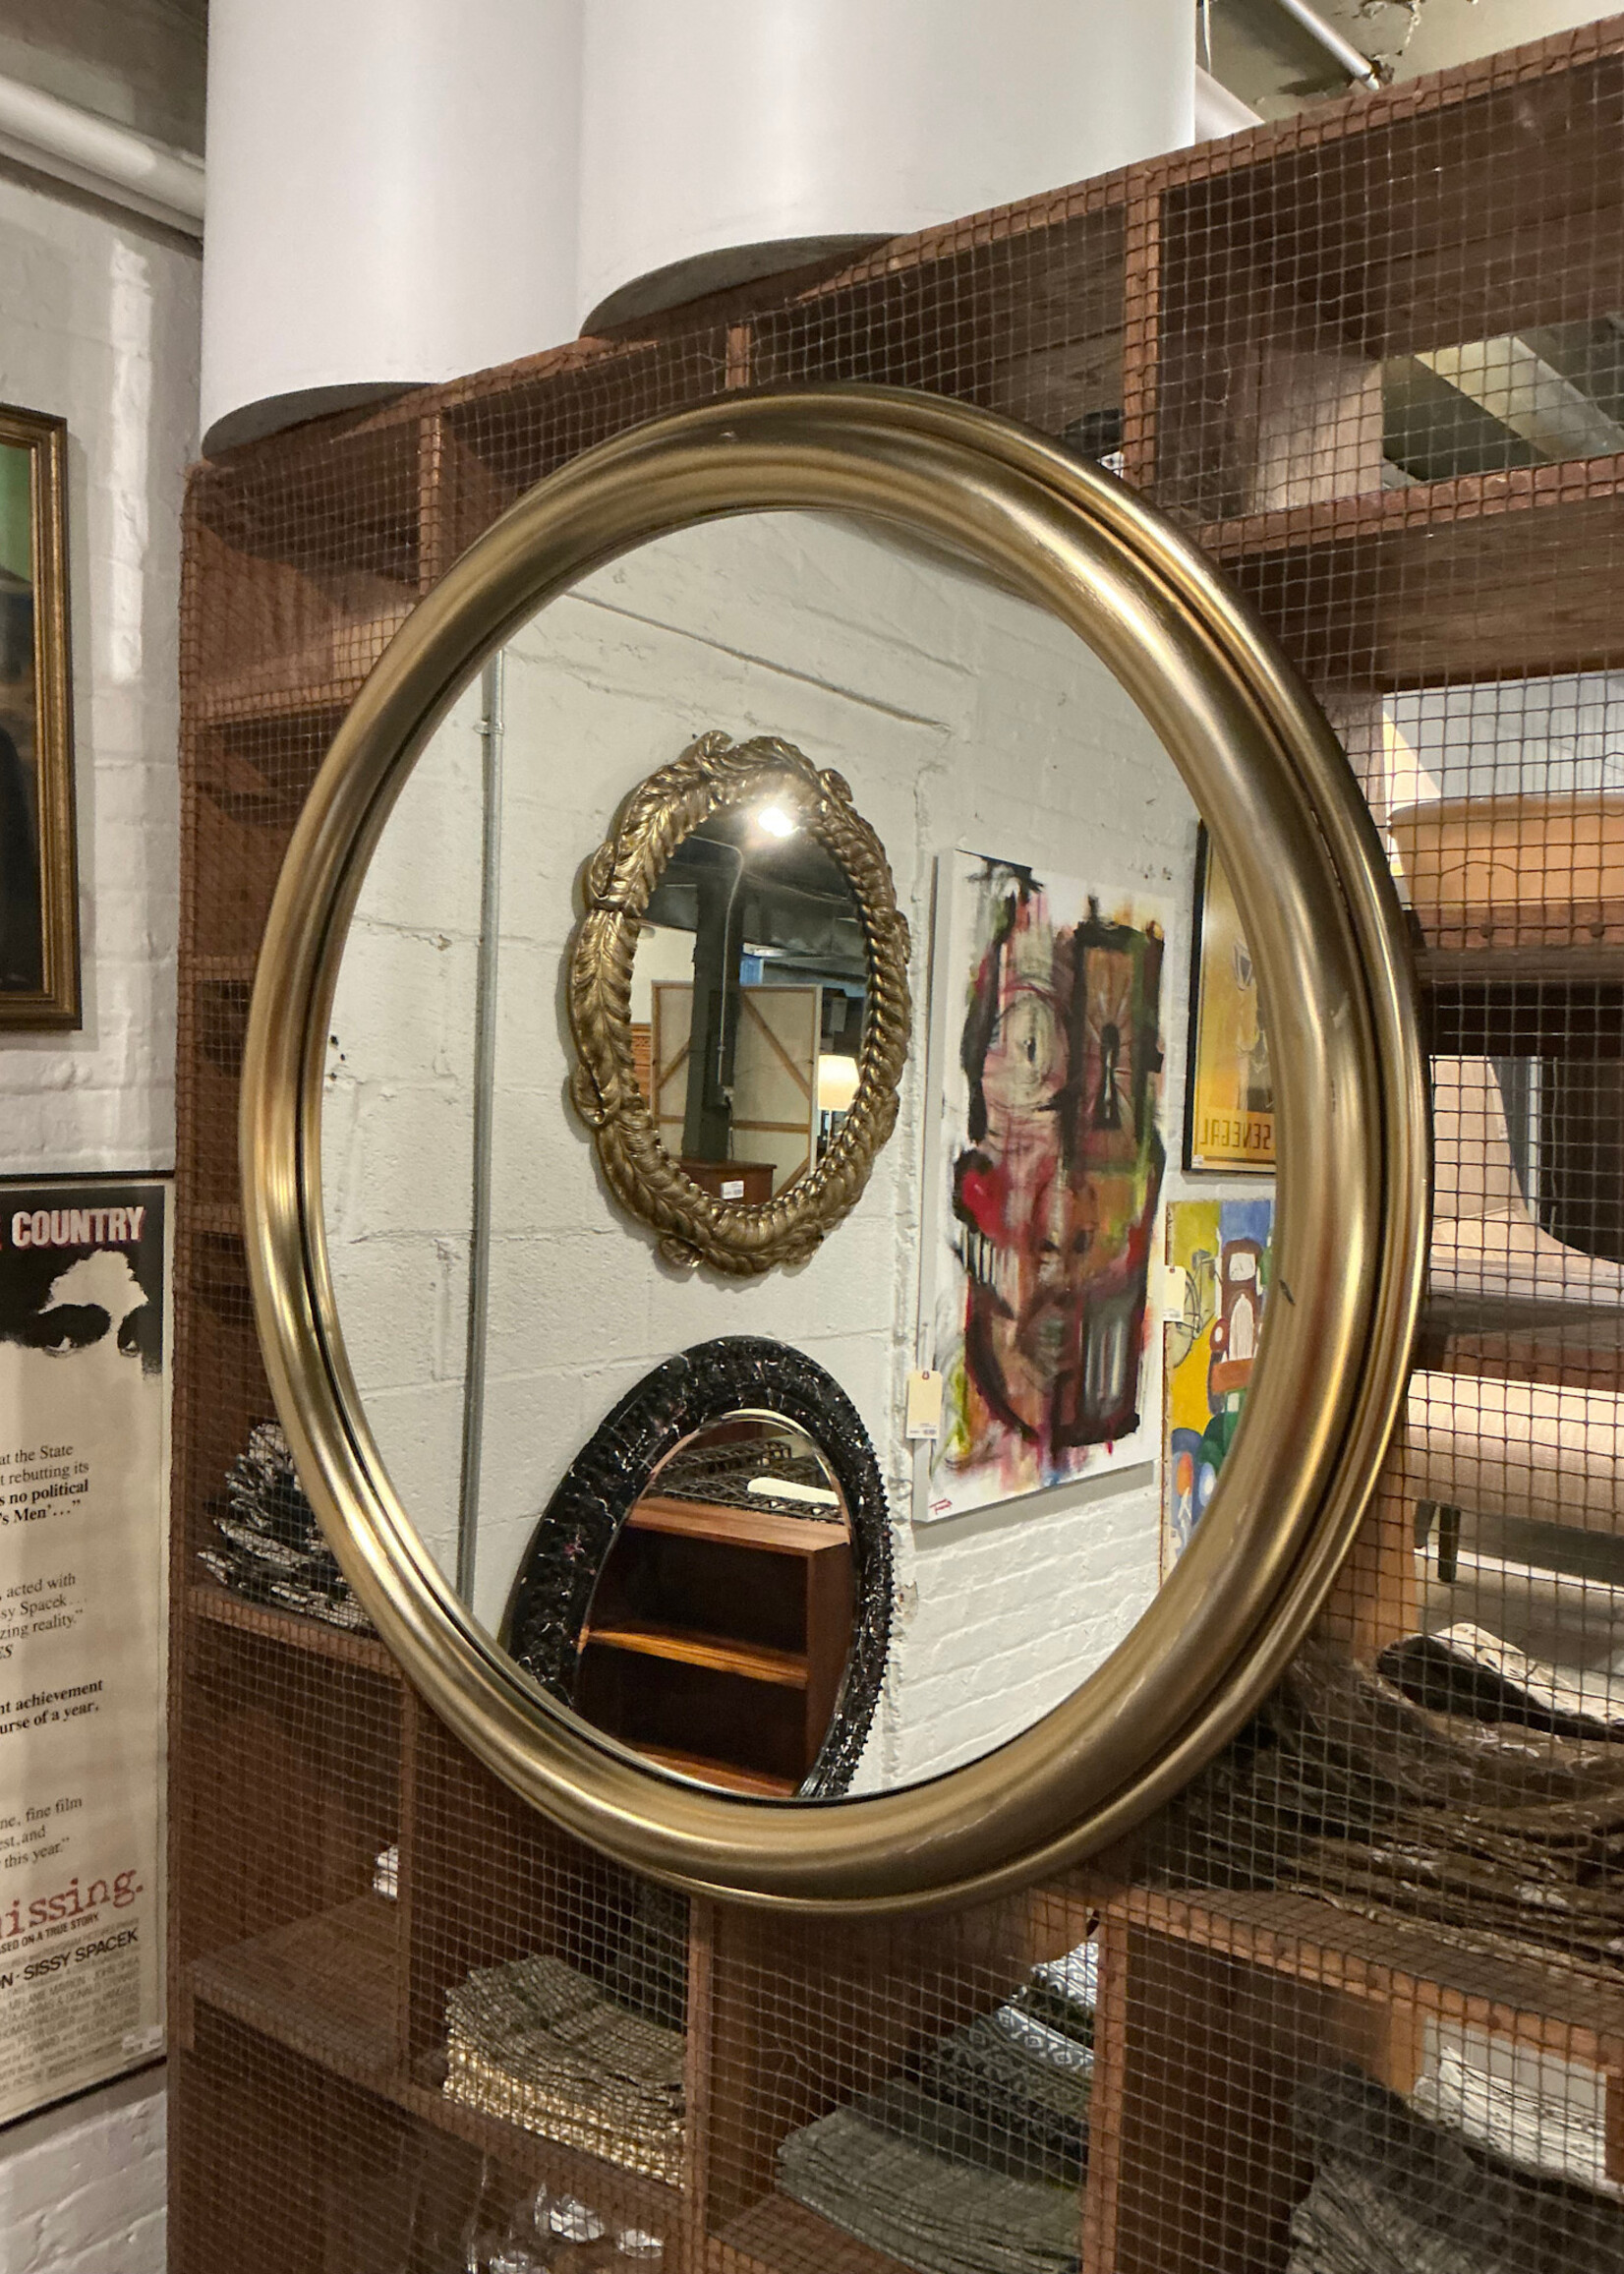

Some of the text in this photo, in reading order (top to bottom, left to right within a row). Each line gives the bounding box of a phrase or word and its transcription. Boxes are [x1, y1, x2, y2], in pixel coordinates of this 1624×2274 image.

[12, 1205, 145, 1250] COUNTRY
[15, 1449, 35, 1464] the
[39, 1445, 74, 1460] State
[9, 1465, 70, 1485] rebutting
[74, 1461, 89, 1475] its
[10, 1492, 28, 1504] no
[31, 1478, 88, 1503] political
[7, 1573, 76, 1598] acted with
[16, 1679, 103, 1711] achievement
[33, 1709, 48, 1726] of
[51, 1710, 60, 1721] a
[26, 1807, 51, 1822] fine
[55, 1798, 83, 1813] film
[22, 1824, 46, 1843] and
[5, 1851, 29, 1868] this
[0, 1869, 144, 1939] issing.
[0, 1939, 19, 1954] SED
[45, 1923, 68, 1939] TRUE
[24, 1952, 71, 1980] SISSY
[75, 1928, 139, 1962] SPACEK
